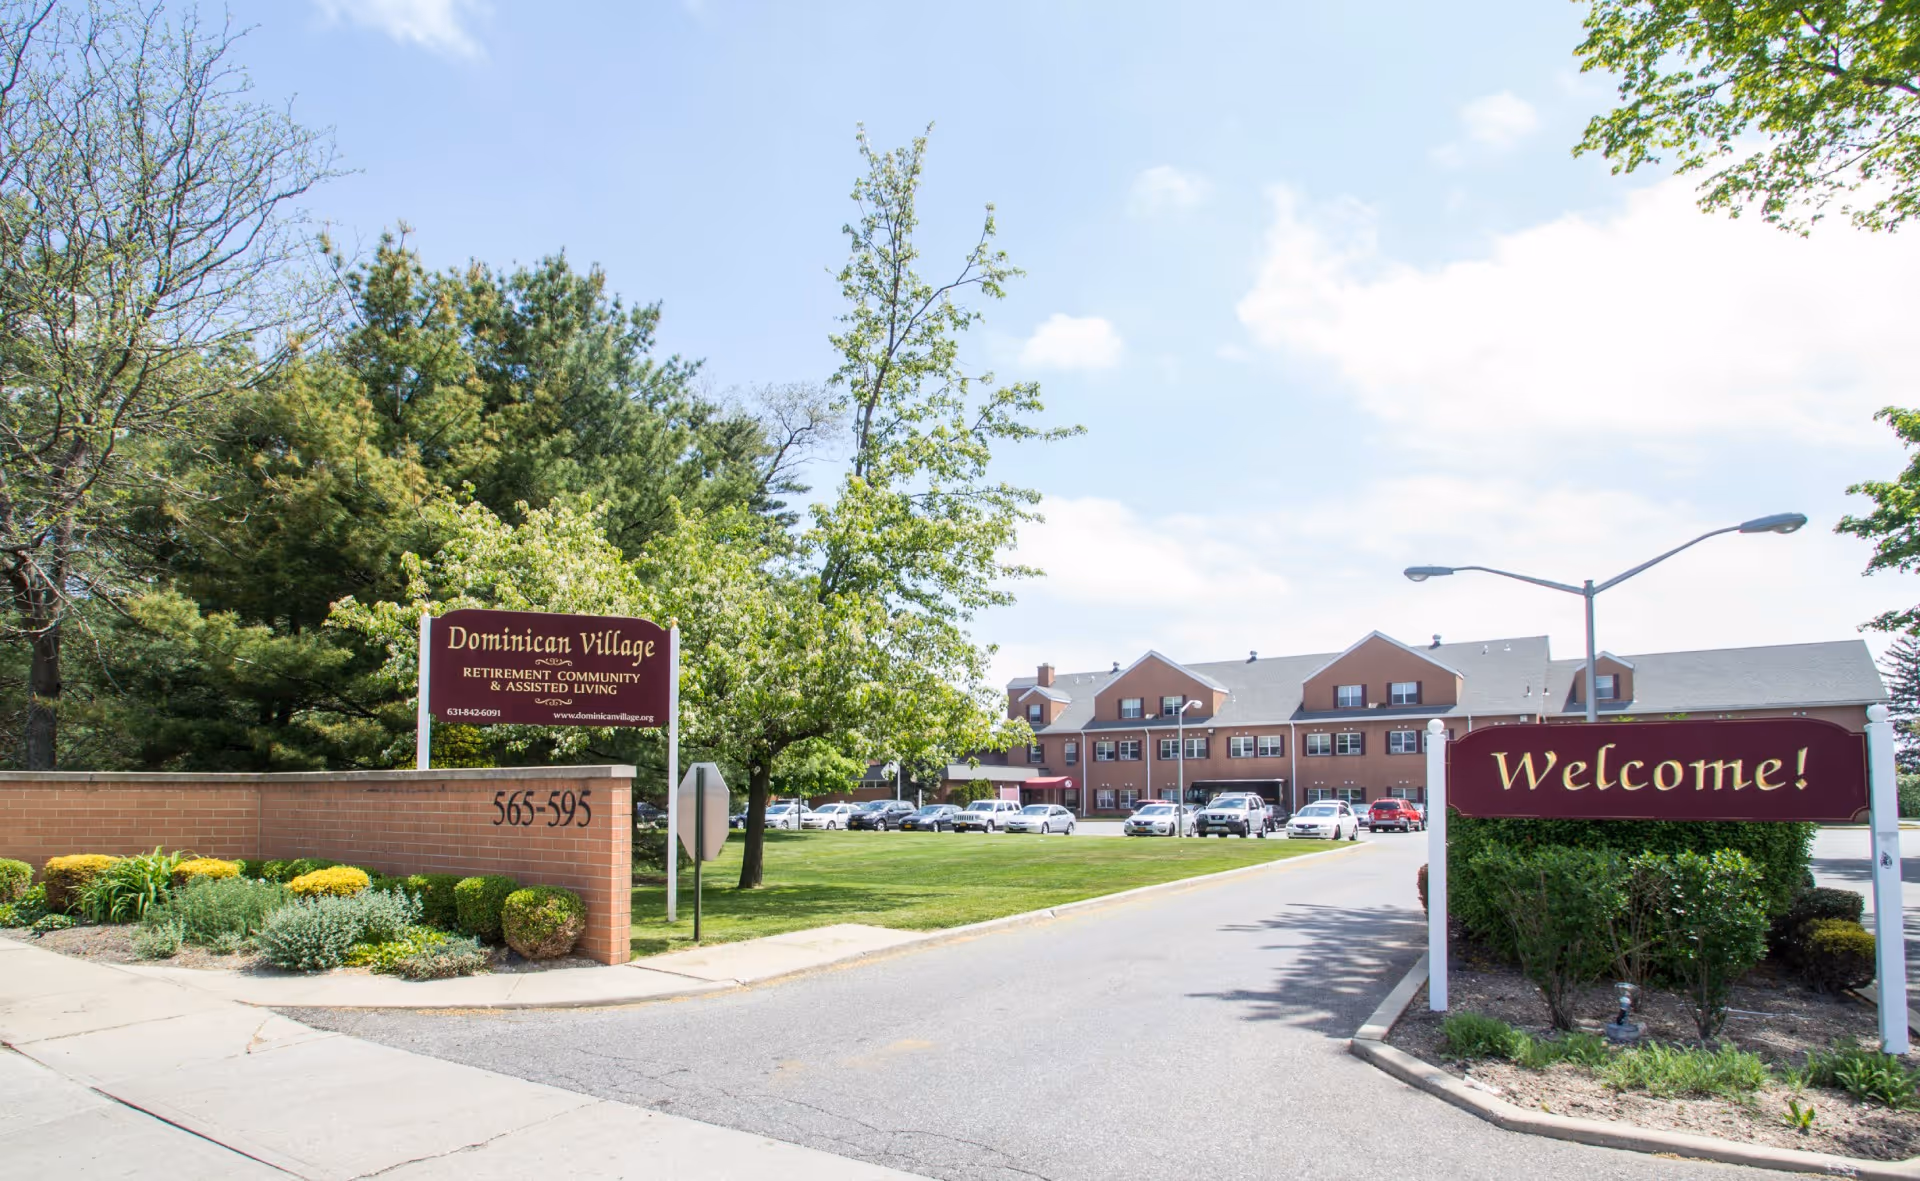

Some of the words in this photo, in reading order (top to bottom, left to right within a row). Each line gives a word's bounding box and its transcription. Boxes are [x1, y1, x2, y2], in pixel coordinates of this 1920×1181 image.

[447, 626, 572, 654] Dominican
[579, 630, 656, 667] Village
[463, 667, 551, 681] RETIREMENT
[557, 671, 641, 684] COMMUNITY
[490, 681, 501, 692] &
[506, 681, 568, 693] ASSISTED
[574, 683, 618, 695] LIVING
[447, 708, 501, 717] 631-842-6091
[553, 711, 655, 723] www.dominicanvillage.org
[1490, 743, 1808, 791] Welcome!
[493, 790, 592, 828] 565-595
